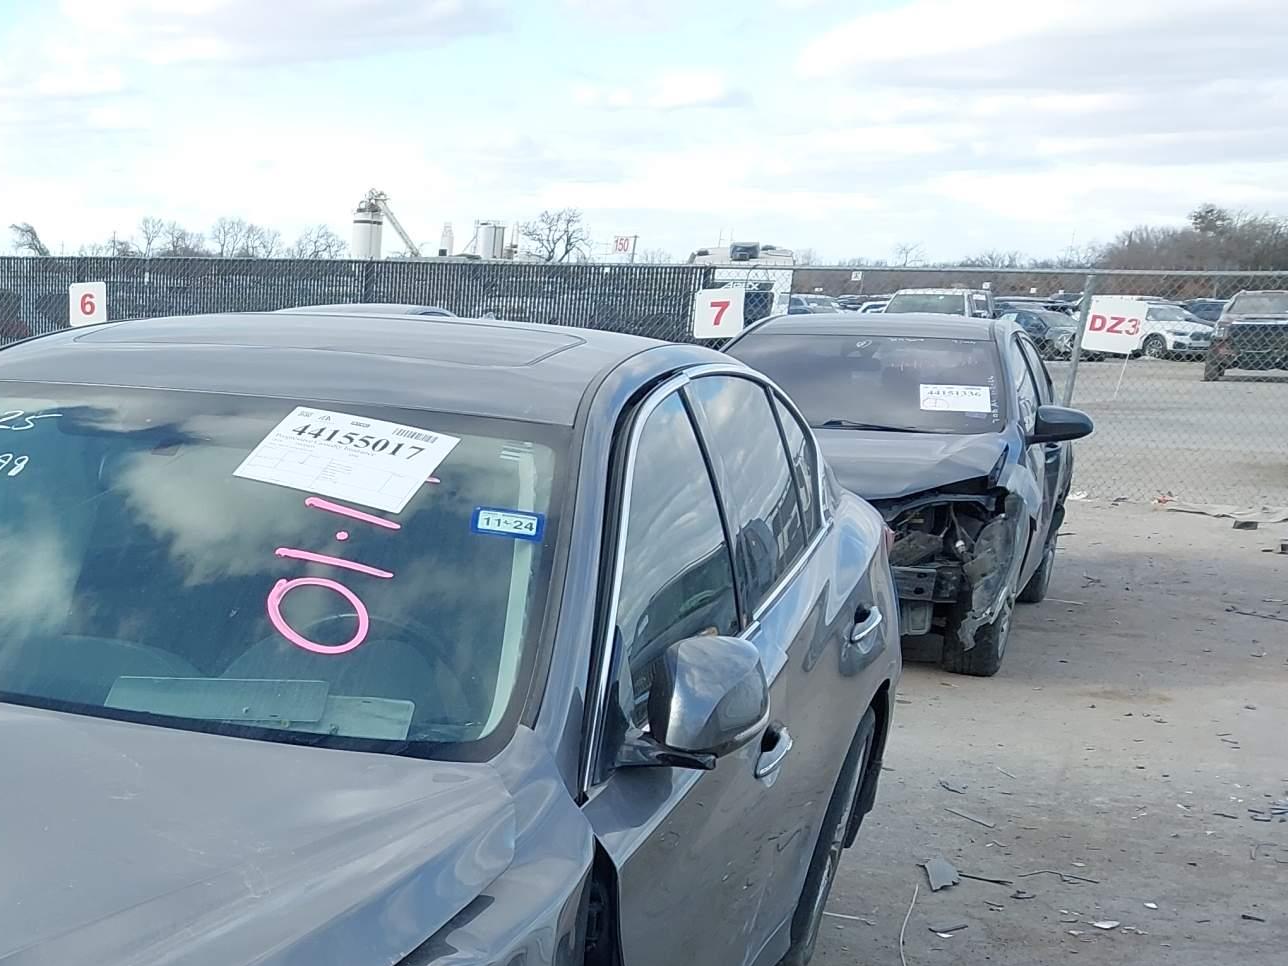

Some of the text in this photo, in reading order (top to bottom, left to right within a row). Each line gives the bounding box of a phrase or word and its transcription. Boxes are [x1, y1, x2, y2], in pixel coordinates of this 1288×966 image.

[80, 293, 96, 316] 6
[710, 301, 730, 326] 7
[1088, 314, 1141, 336] DZ3
[291, 423, 426, 460] 44155017
